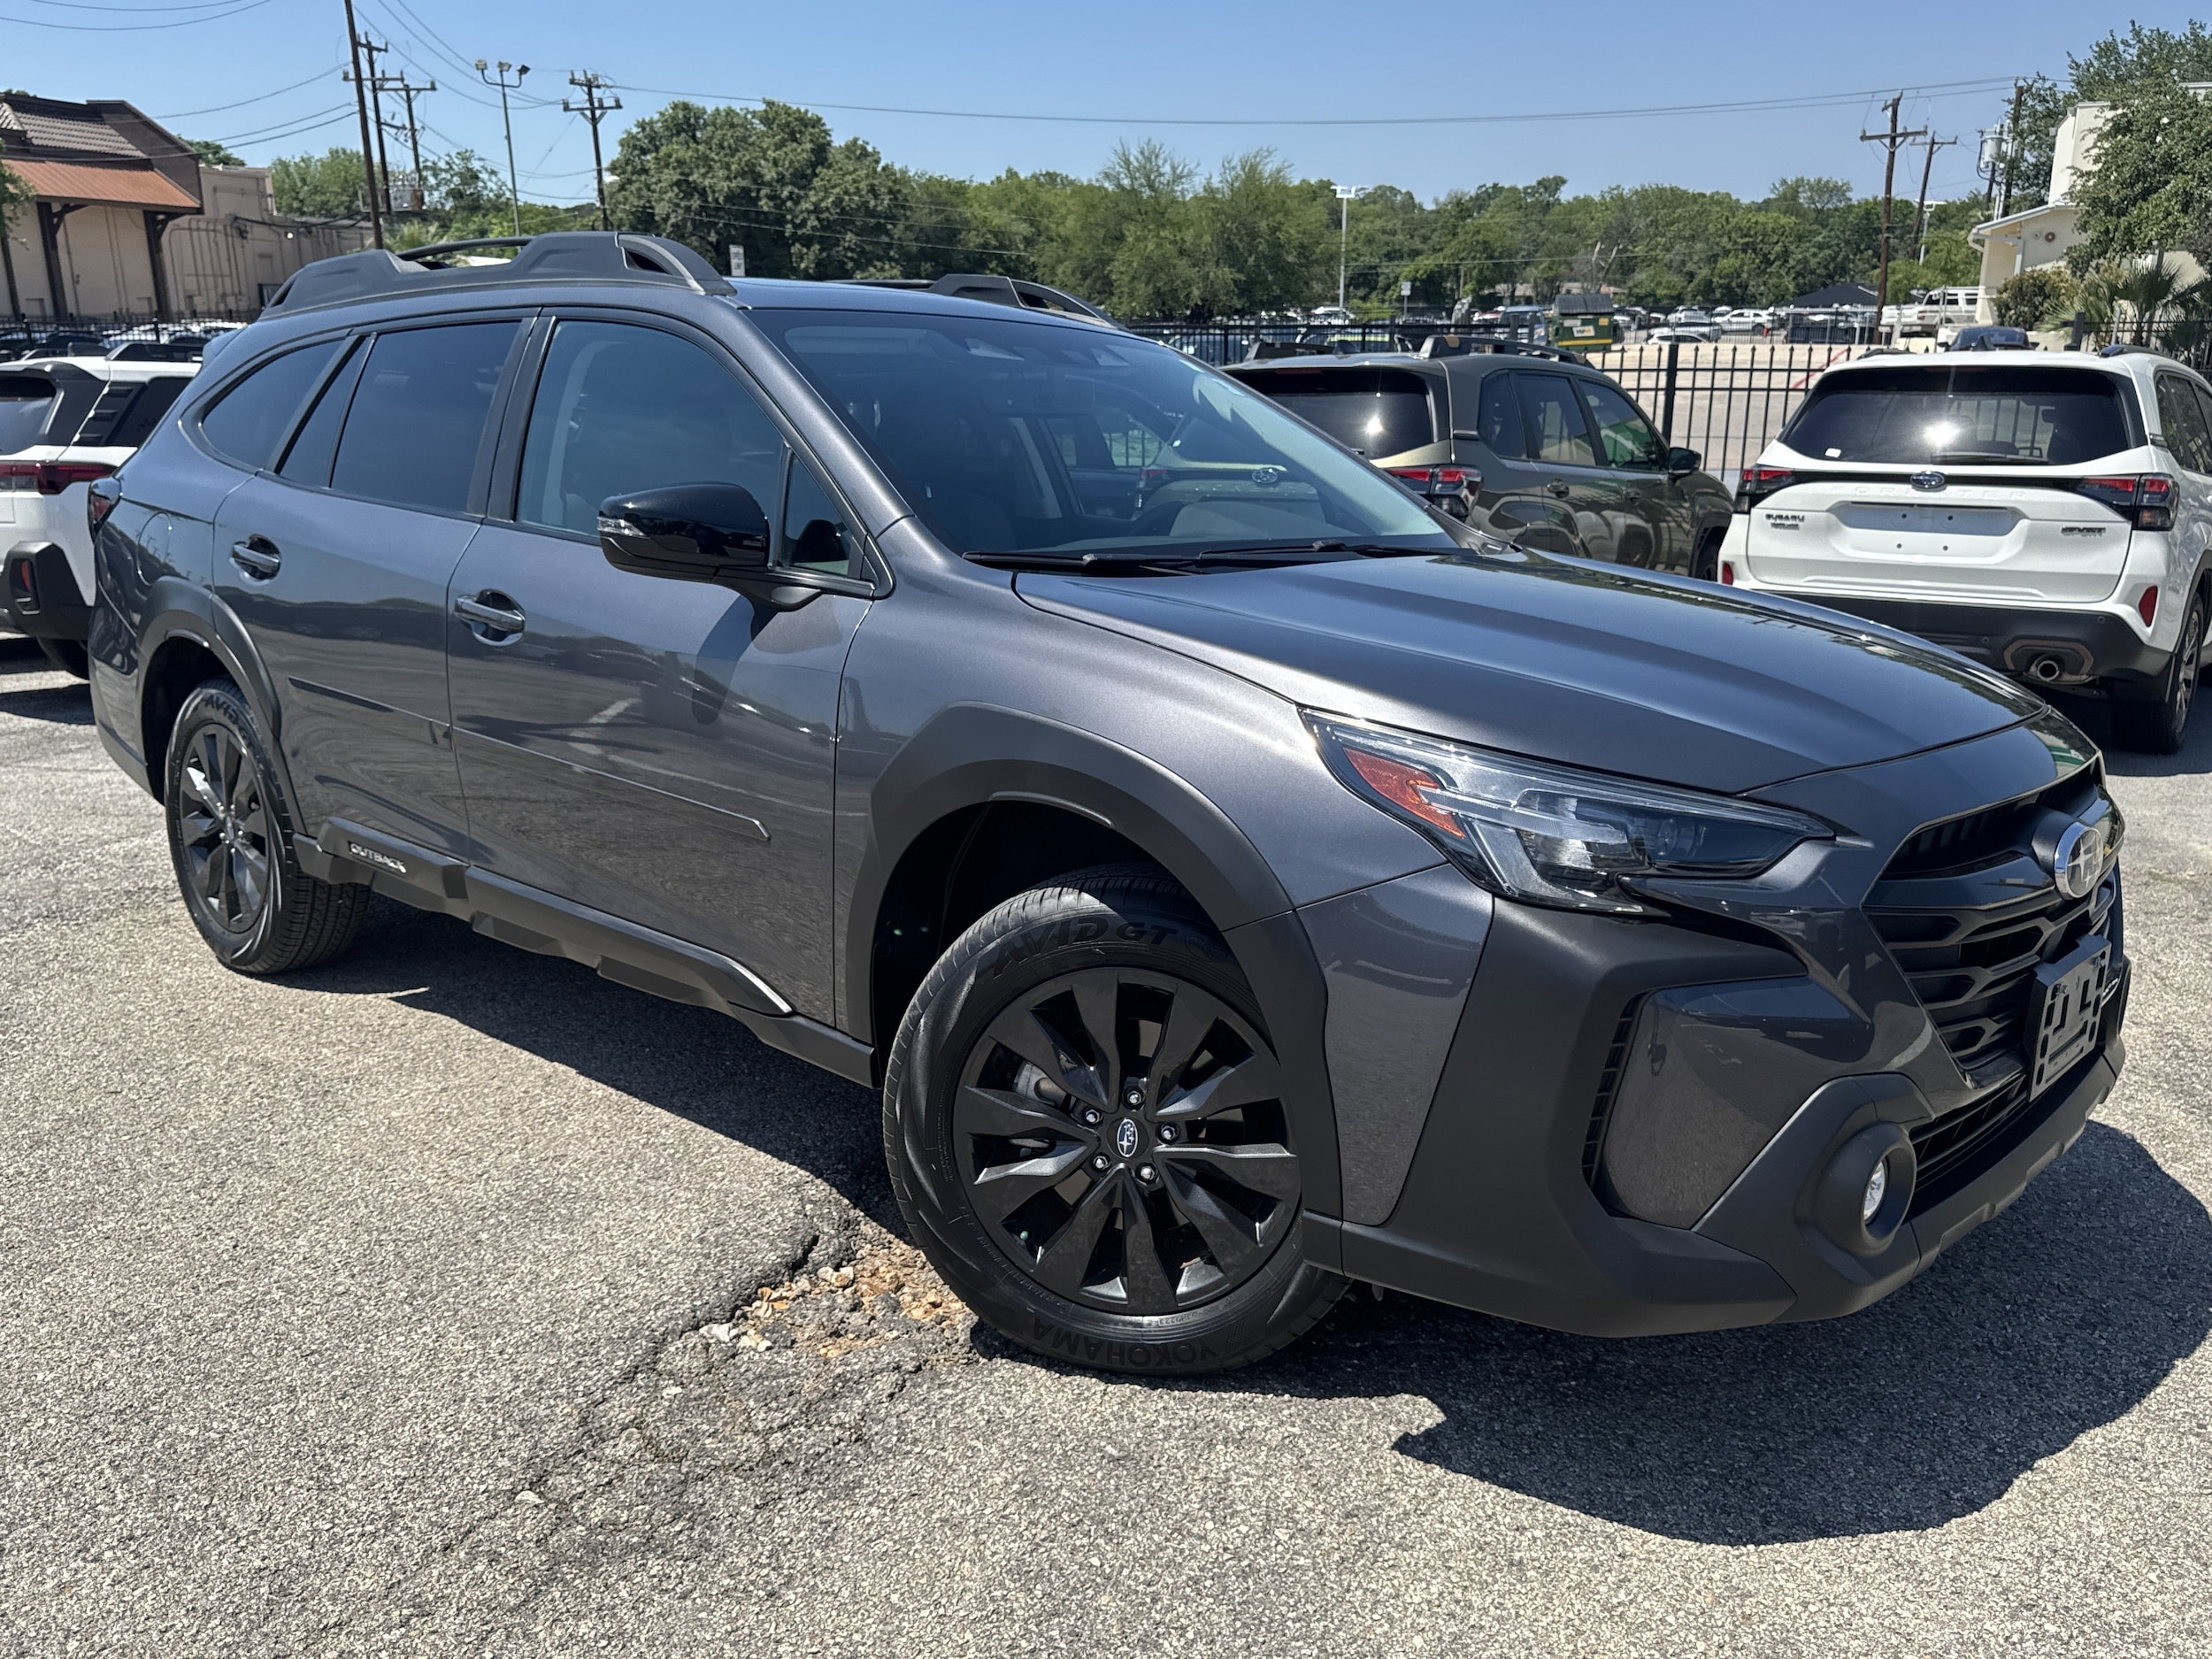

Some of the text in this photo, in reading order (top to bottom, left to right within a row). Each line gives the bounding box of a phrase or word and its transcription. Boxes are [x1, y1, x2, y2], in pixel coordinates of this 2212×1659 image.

[350, 842, 407, 874] OUTBACK
[992, 916, 1179, 979] AVID GT
[1033, 1316, 1217, 1367] YOKOHAMA
